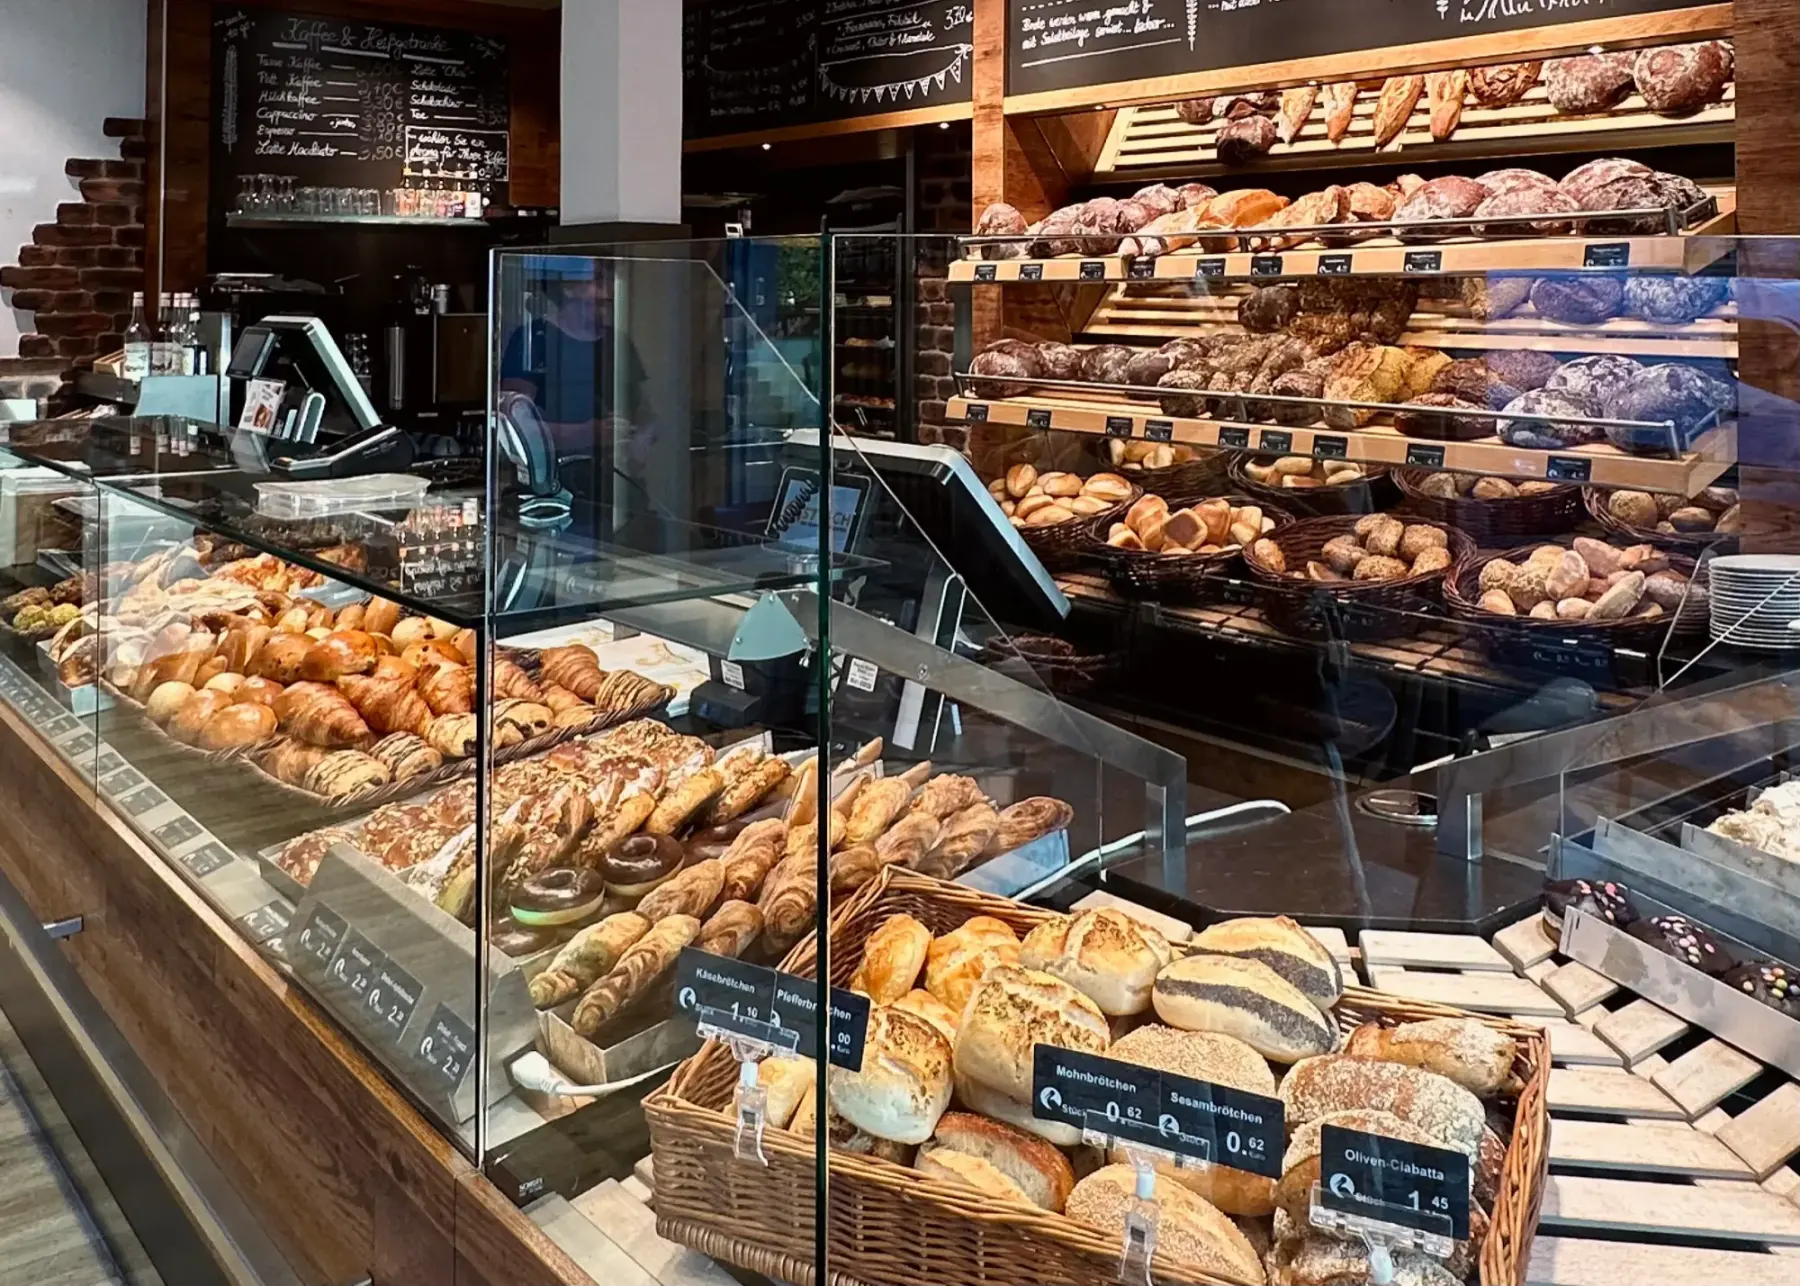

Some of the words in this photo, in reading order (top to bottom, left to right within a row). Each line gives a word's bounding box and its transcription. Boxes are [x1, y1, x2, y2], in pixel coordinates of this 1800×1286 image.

[281, 17, 340, 53] Kaffee
[340, 26, 360, 46] &
[256, 107, 318, 125] Cappuccino
[409, 108, 429, 120] Tee
[696, 967, 756, 994] Käsebrötchen
[1056, 1065, 1137, 1093] Mohnbrötchen
[1171, 1092, 1263, 1125] Sesambrötchen
[1345, 1149, 1445, 1181] Oliven-Ciabatta
